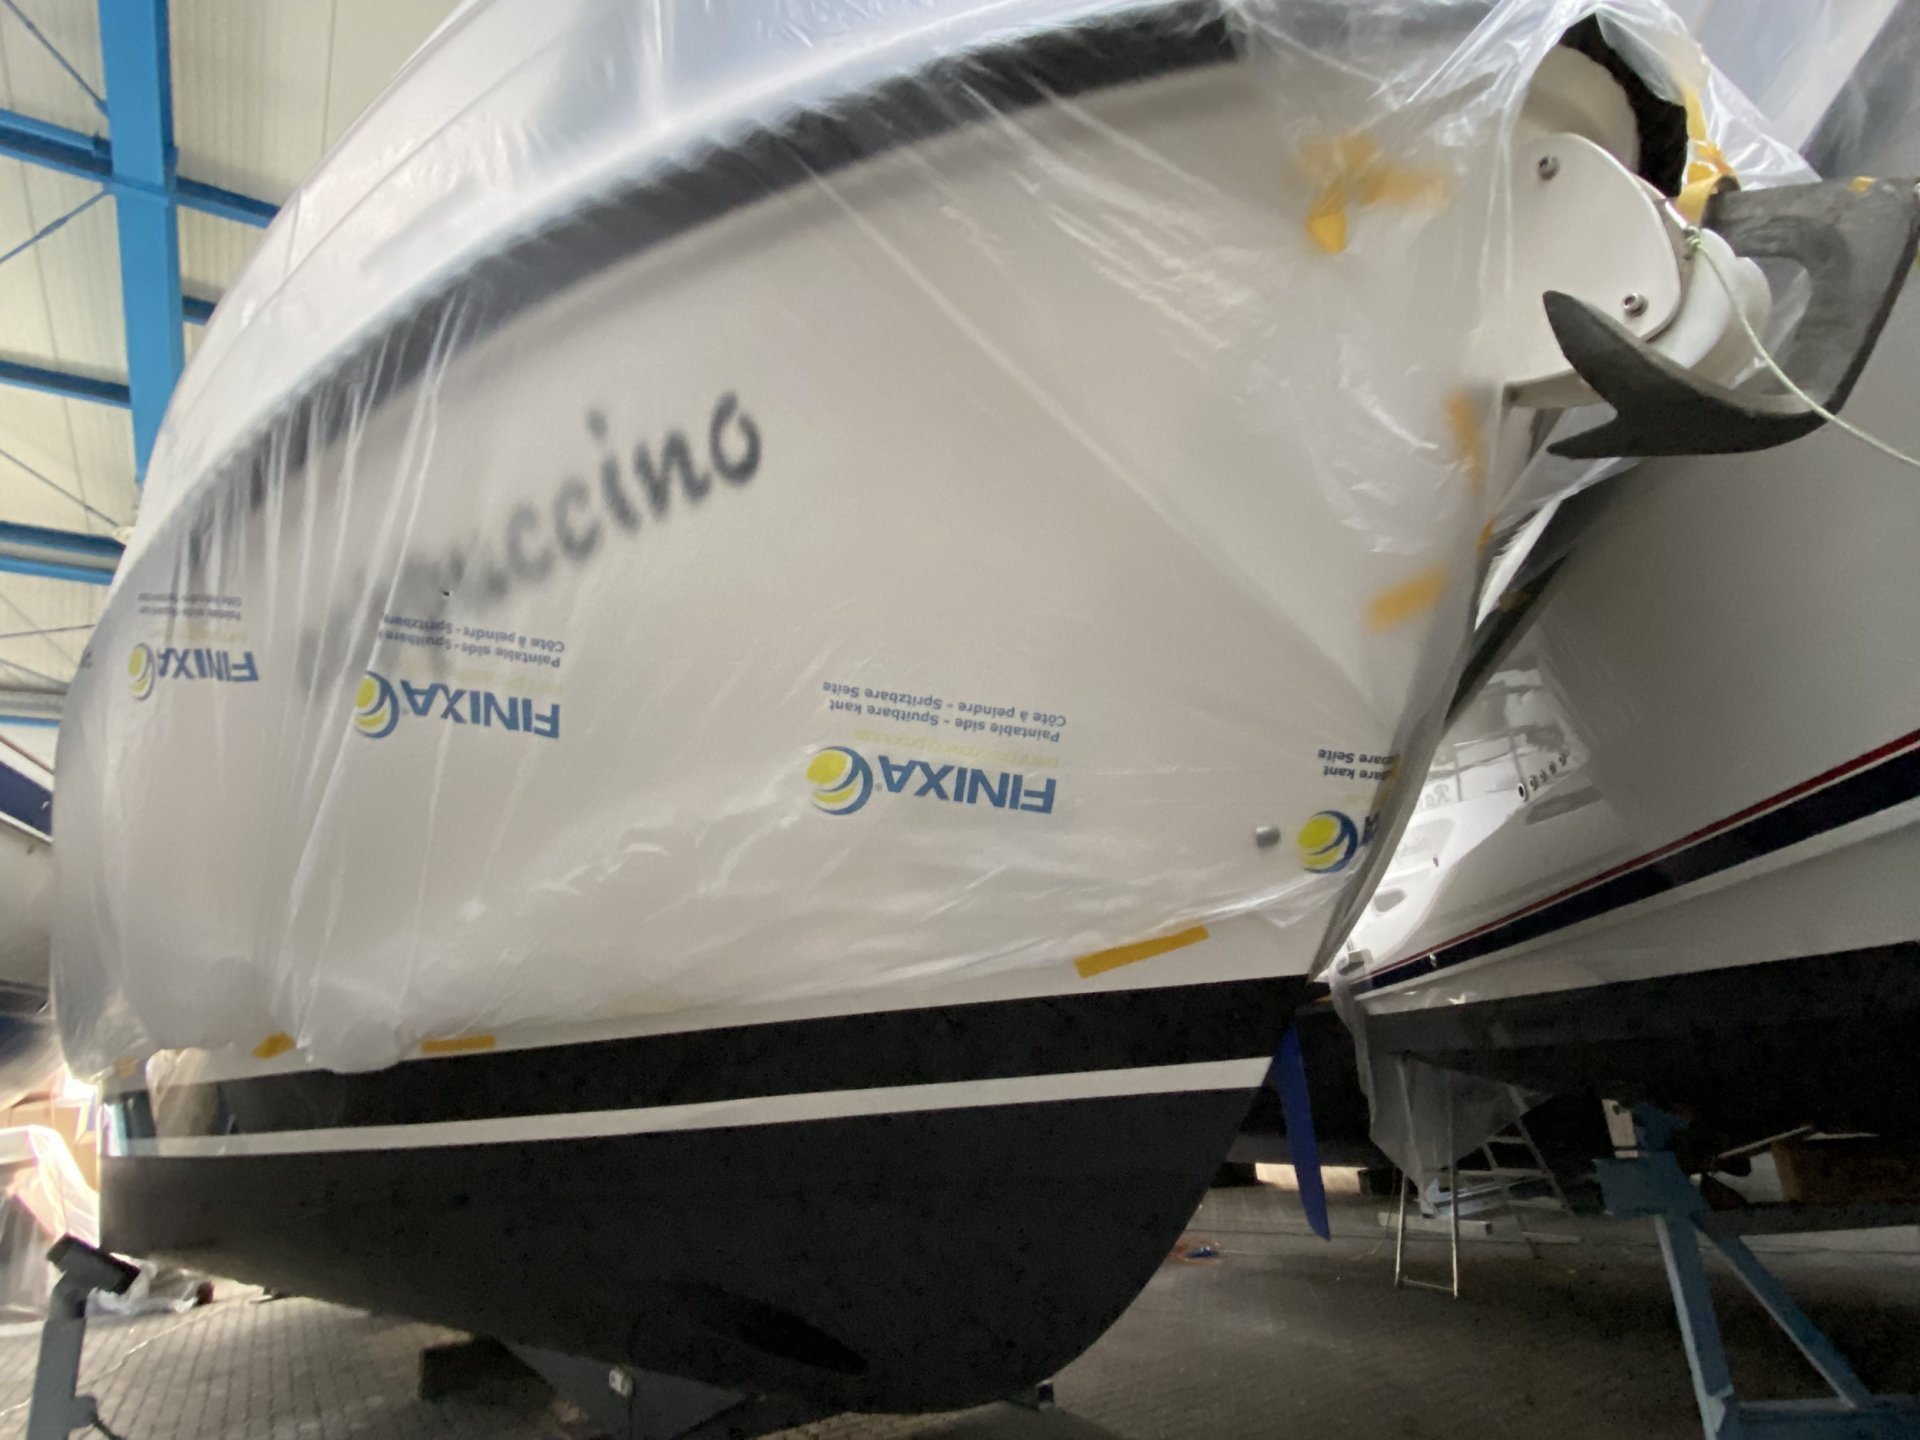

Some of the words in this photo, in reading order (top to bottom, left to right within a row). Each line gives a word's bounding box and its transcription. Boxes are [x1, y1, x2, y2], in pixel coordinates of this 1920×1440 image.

[518, 635, 528, 649] à
[530, 637, 566, 653] Côte
[495, 647, 561, 669] Paintable
[822, 681, 860, 698] Seite
[864, 687, 944, 710] Spritzbare
[400, 679, 561, 740] FINIXA
[829, 699, 862, 715] kant
[866, 704, 940, 726] Spuitbare
[957, 701, 1016, 718] peindre
[1019, 709, 1029, 721] à
[954, 717, 986, 732] side
[1032, 711, 1067, 727] Côte
[989, 722, 1061, 743] Paintable
[1317, 748, 1356, 764] Seite
[1323, 765, 1356, 780] kant
[878, 755, 1057, 815] FINIXA
